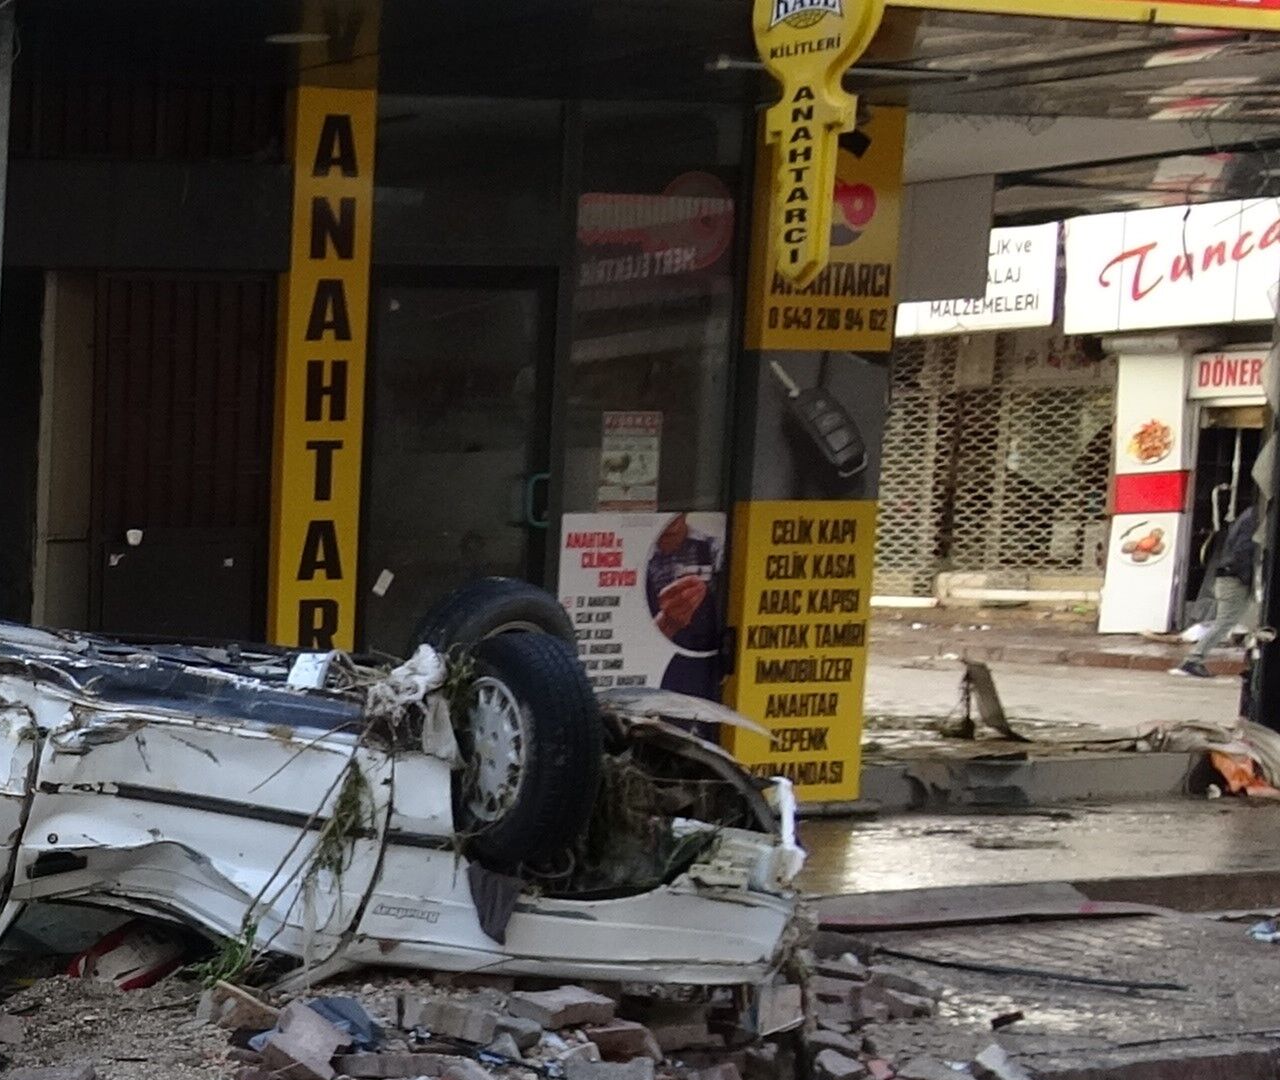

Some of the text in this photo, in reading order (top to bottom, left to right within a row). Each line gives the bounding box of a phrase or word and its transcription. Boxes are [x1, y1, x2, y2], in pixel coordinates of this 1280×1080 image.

[770, 33, 841, 59] KİLİTLERİ
[783, 86, 815, 264] ANAHTARCI
[1198, 355, 1263, 388] DÖNER
[818, 518, 856, 545] KAPI
[812, 554, 856, 579] KASA
[747, 623, 809, 650] KONTAK
[765, 692, 839, 719] ANAHTAR
